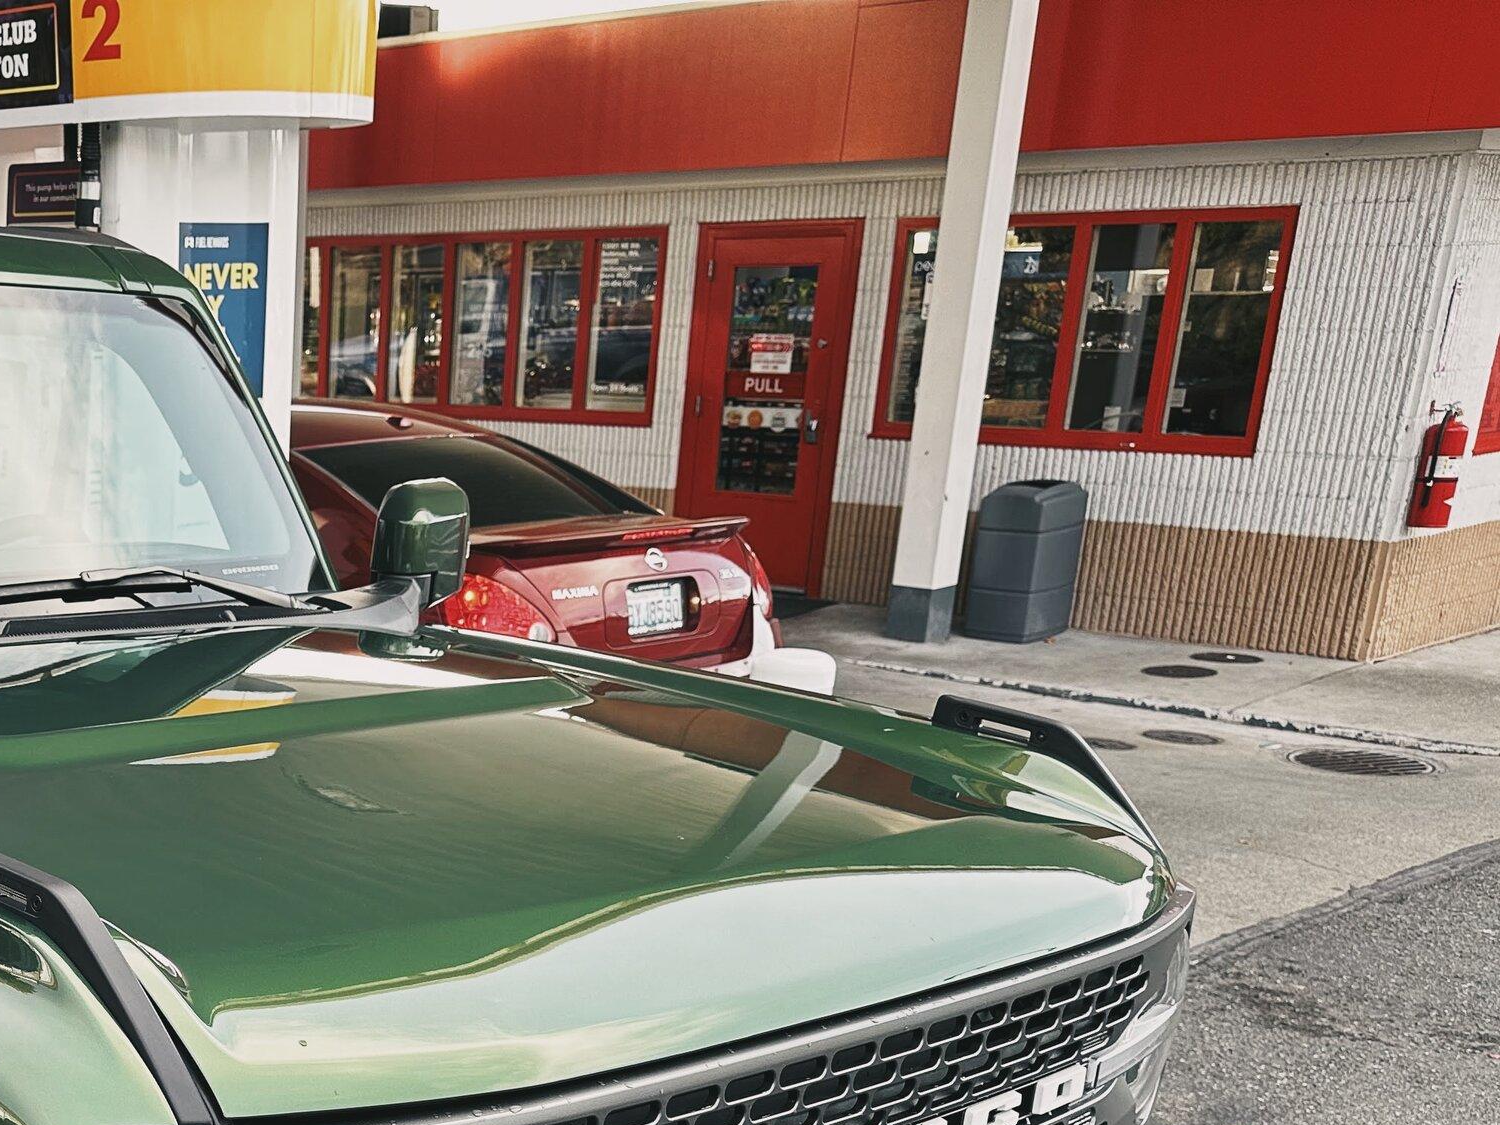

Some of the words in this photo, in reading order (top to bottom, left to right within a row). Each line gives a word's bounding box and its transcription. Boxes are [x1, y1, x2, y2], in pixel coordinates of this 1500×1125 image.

[82, 0, 121, 62] 2
[183, 262, 259, 290] NEVER
[744, 377, 783, 393] PULL
[551, 585, 599, 600] MAXIMA
